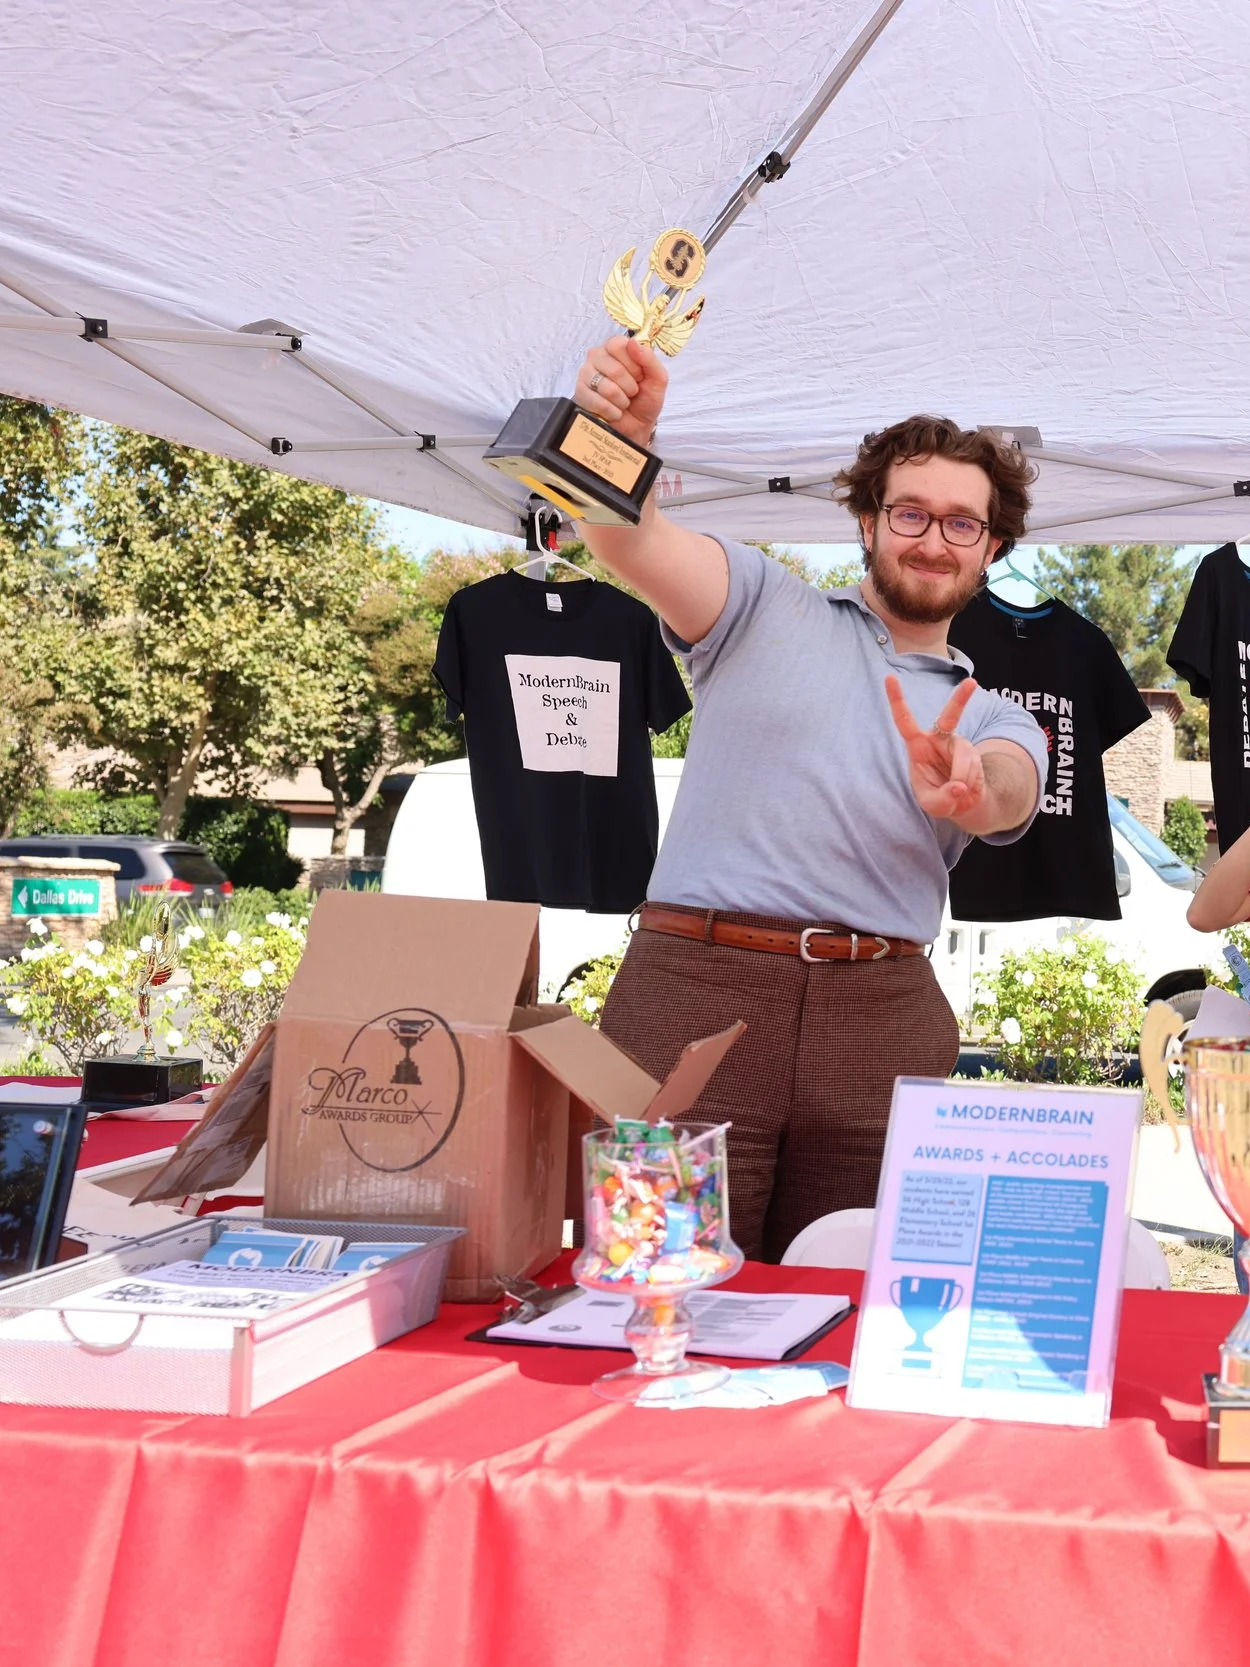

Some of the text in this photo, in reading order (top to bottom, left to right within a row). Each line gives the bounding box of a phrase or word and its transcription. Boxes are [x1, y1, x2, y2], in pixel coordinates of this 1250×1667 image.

[517, 673, 611, 694] ModernBrain
[542, 694, 588, 710] Speech
[982, 687, 1073, 718] ODERN
[565, 712, 578, 726] &
[546, 732, 588, 748] Debte
[1056, 717, 1074, 796] BRAIN
[32, 888, 95, 905] Dallas Drive
[301, 1067, 408, 1115] Marco
[319, 1110, 412, 1124] AWARDS GROUP
[951, 1105, 1094, 1125] MODERNBRAIN
[913, 1146, 985, 1162] AWARDS
[1007, 1151, 1109, 1168] ACCOLADES
